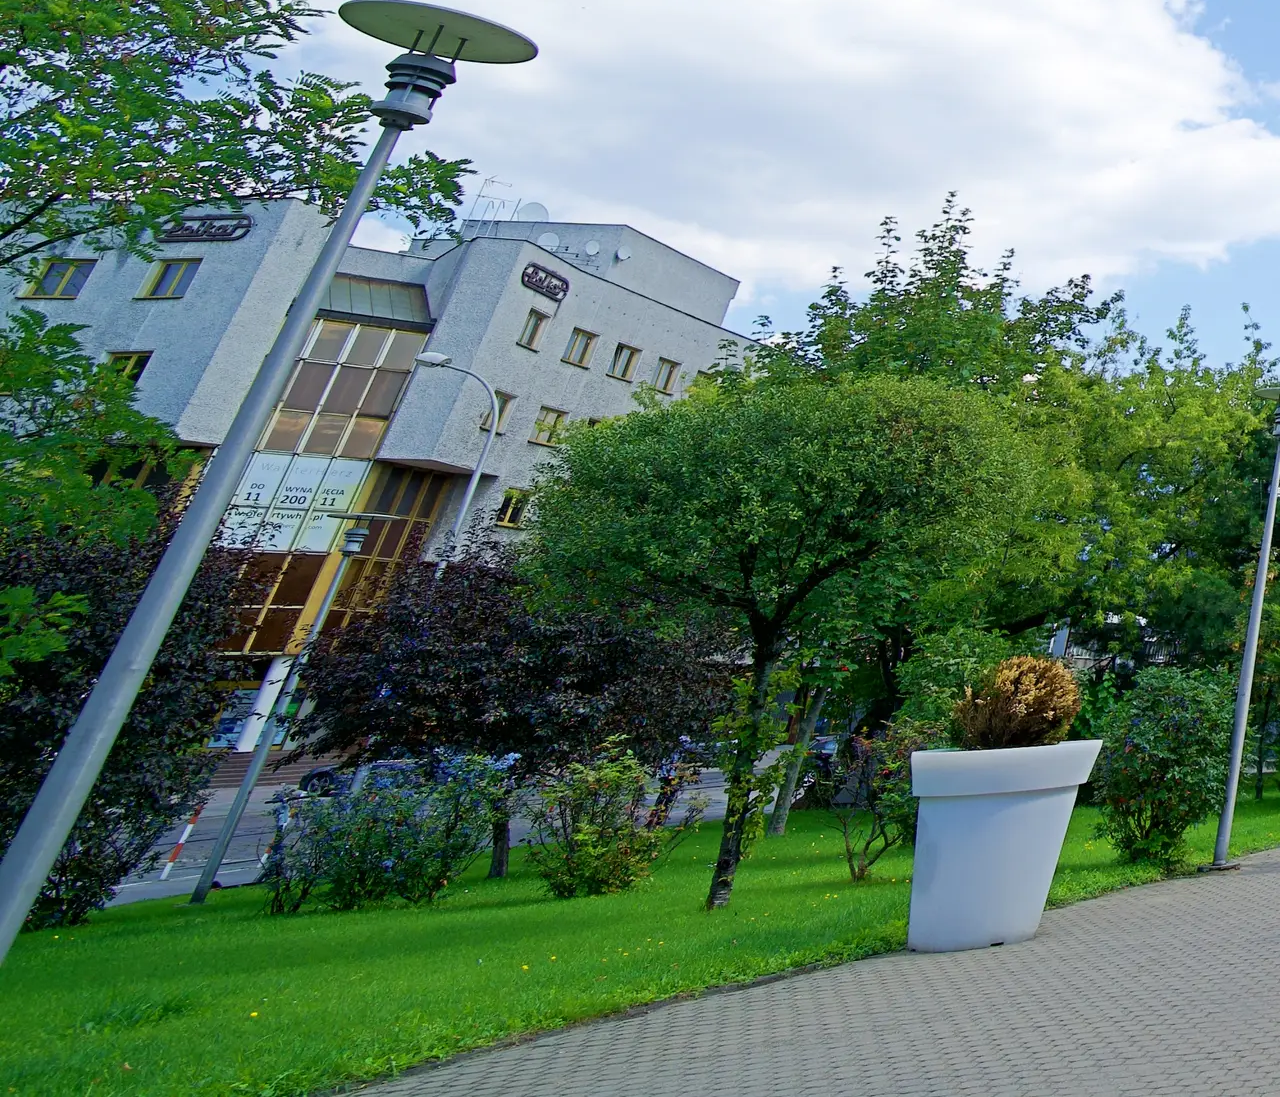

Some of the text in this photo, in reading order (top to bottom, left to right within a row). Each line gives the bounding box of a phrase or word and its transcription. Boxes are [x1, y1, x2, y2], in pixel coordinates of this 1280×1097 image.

[250, 482, 265, 490] DO
[243, 491, 336, 507] 11 200 11
